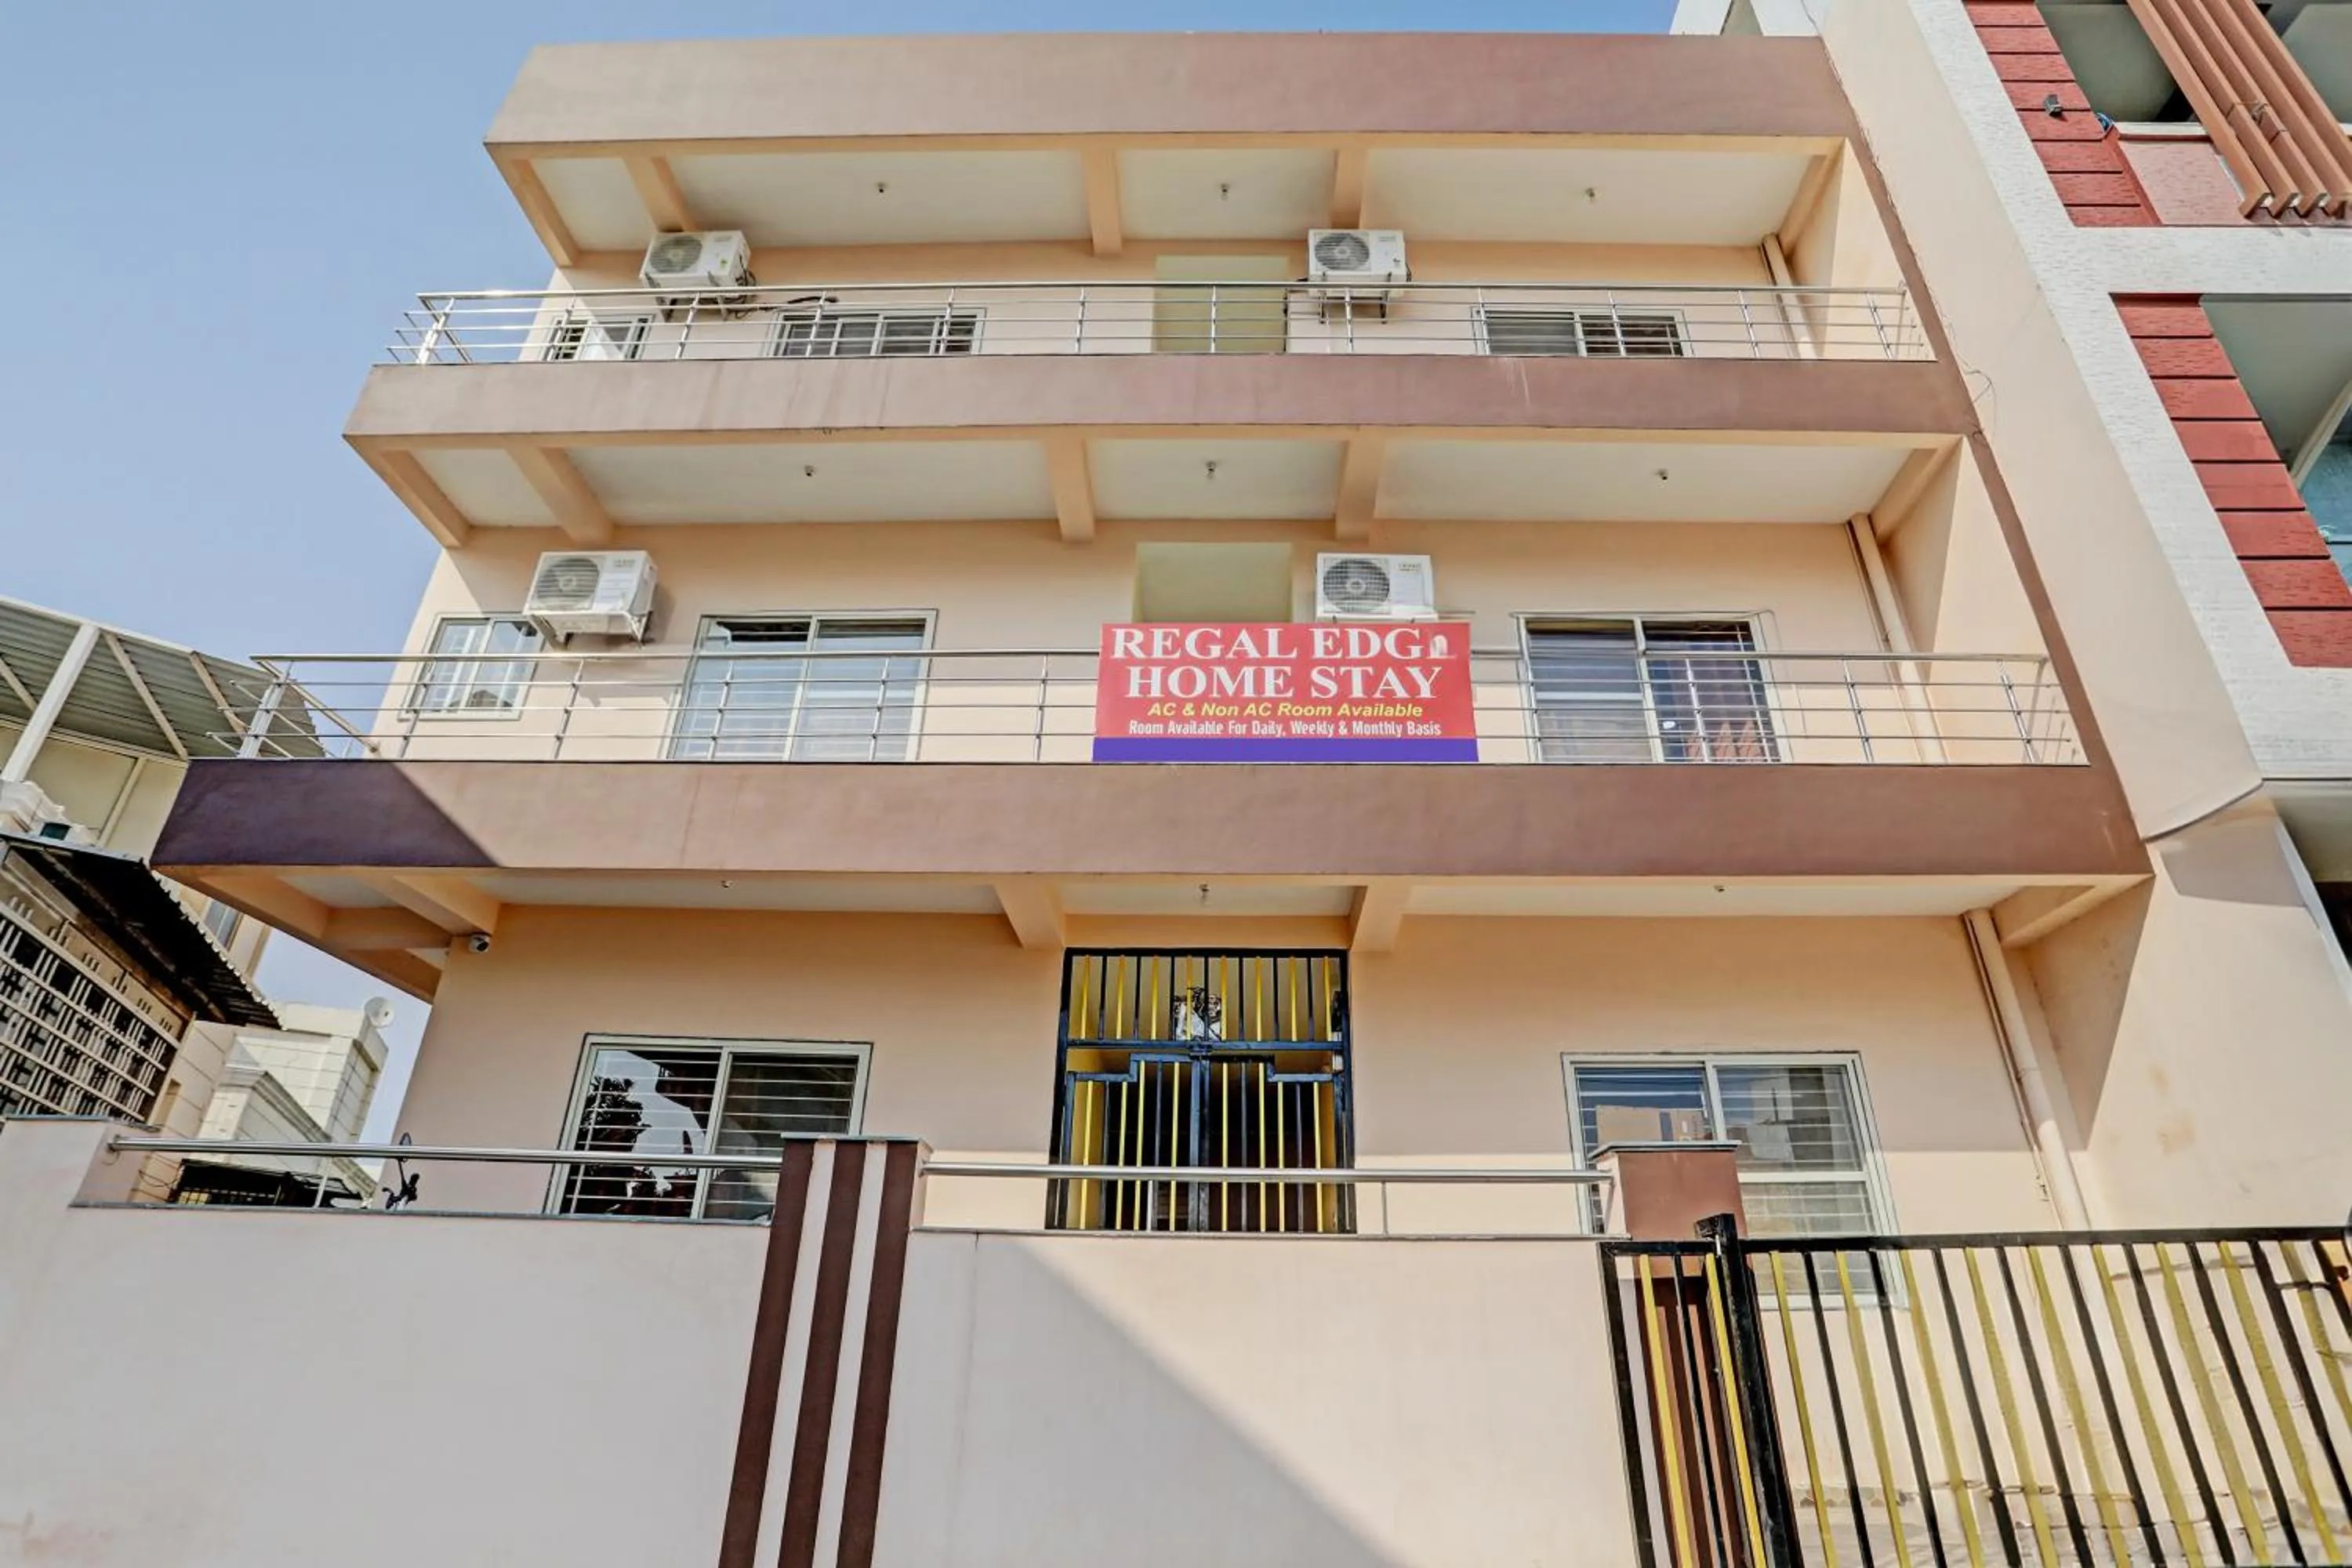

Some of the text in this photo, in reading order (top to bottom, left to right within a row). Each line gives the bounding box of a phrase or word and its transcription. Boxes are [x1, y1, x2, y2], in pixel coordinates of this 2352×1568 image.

[1110, 628, 1297, 659] REGAL
[1125, 666, 1441, 699] HOME STAY
[1147, 702, 1423, 717] AC & Non AC Room Available
[1129, 720, 1441, 739] Room Available For Daily, Weekly & Monthly Basis
